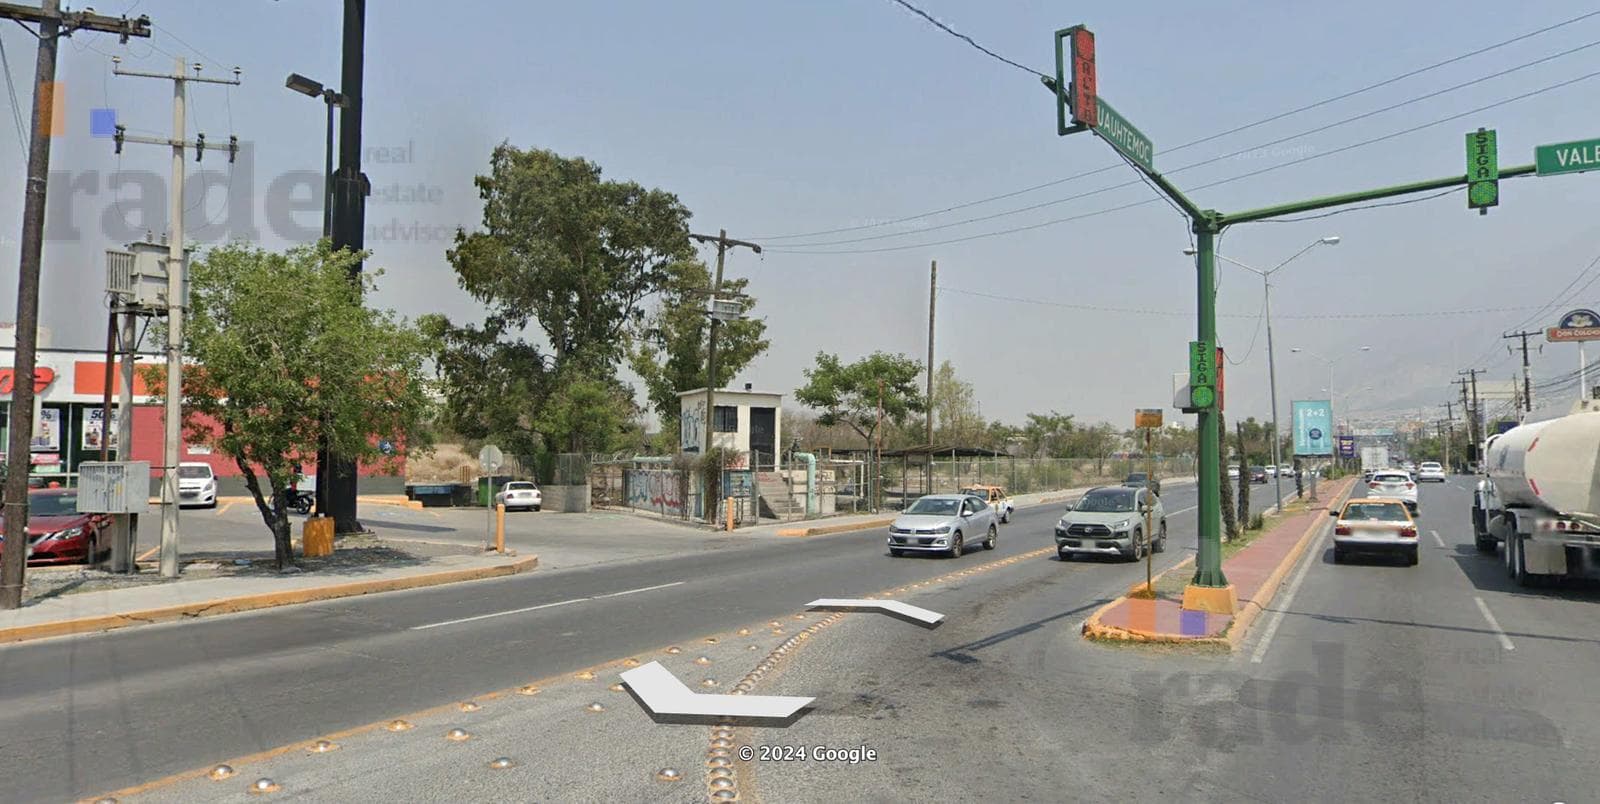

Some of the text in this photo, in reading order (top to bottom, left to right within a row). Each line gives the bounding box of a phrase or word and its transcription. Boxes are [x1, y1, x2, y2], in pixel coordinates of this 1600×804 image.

[1096, 106, 1151, 163] UAUHTEMOC
[1475, 133, 1490, 178] SIGA
[1197, 342, 1207, 384] SIGA
